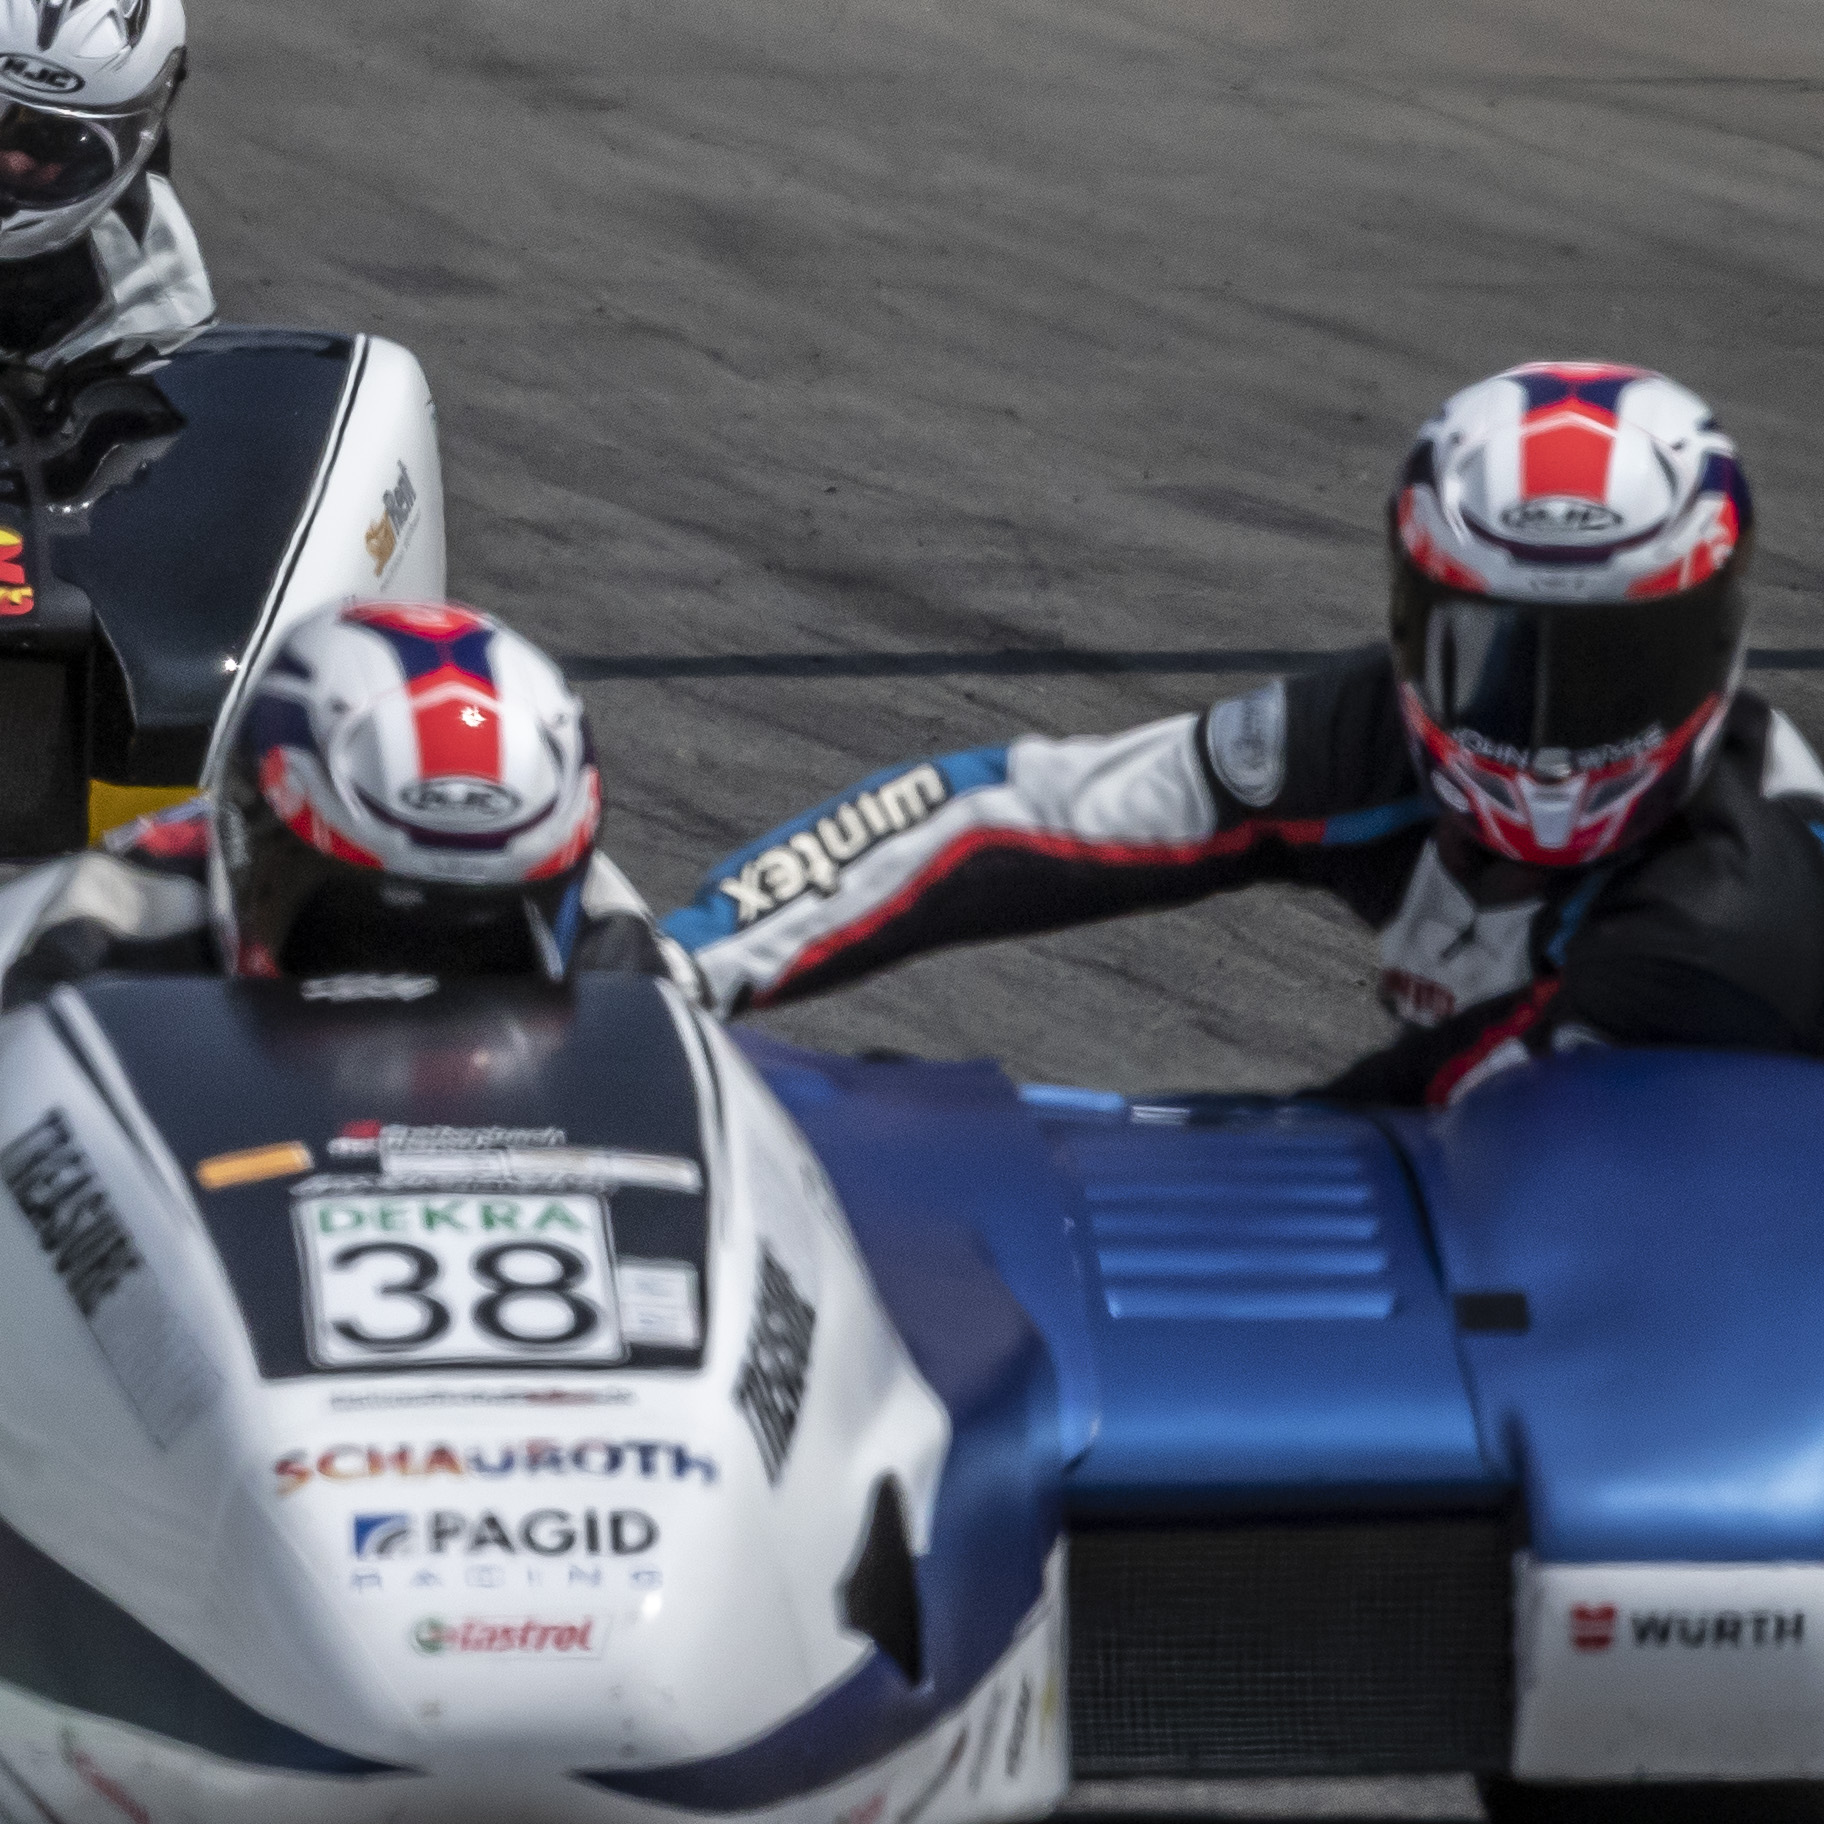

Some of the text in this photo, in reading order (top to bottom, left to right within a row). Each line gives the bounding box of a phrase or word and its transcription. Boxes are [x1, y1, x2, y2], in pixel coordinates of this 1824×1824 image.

[2, 54, 70, 88] HJC
[720, 762, 946, 922] wintex
[318, 1201, 585, 1233] DEKRA
[333, 1239, 599, 1349] 38
[427, 1509, 660, 1556] PAGID
